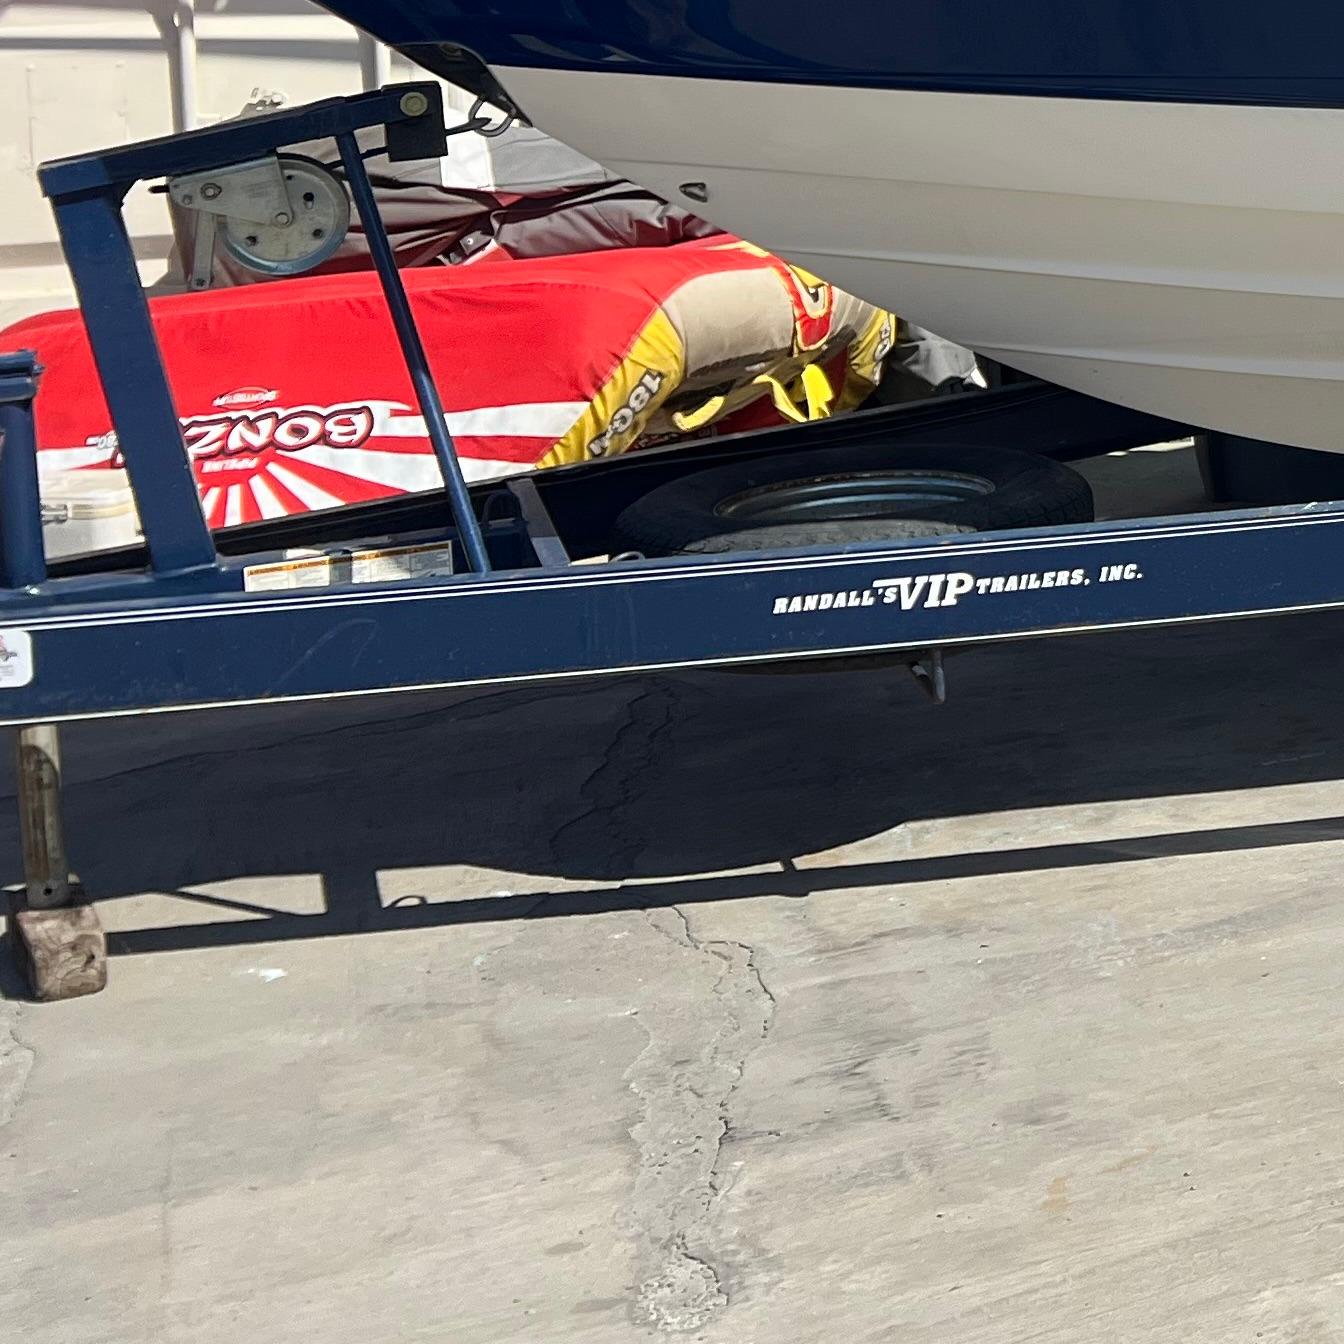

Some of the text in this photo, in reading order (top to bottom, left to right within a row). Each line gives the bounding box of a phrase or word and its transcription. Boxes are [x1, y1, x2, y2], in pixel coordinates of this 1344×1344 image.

[182, 406, 375, 460] BONZ
[772, 563, 1144, 615] RANDALL'S VIP TRAILERS, INC.
